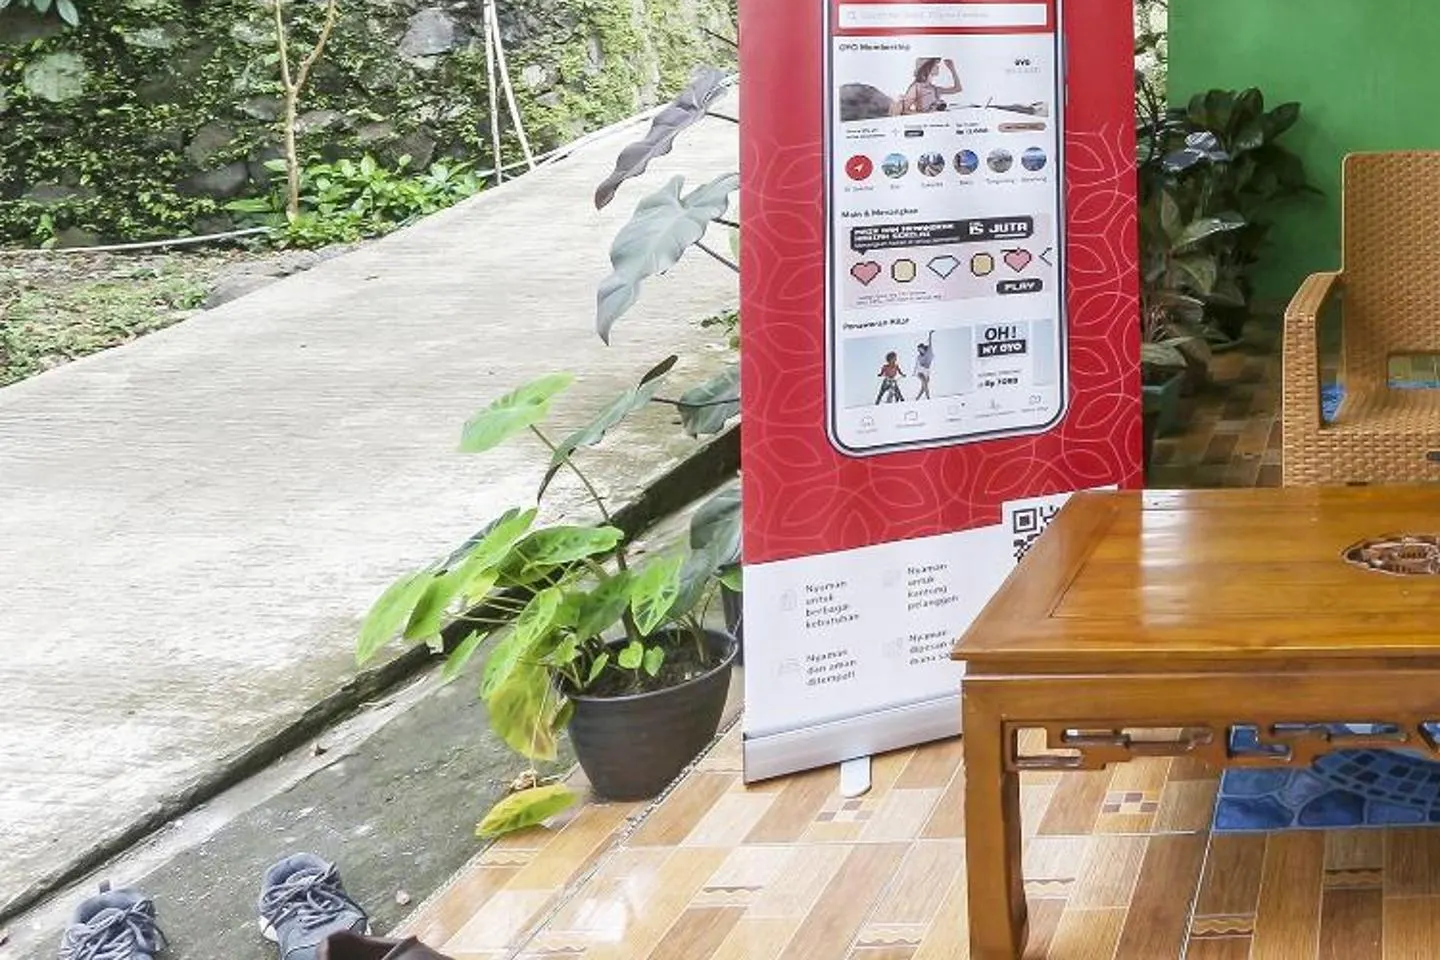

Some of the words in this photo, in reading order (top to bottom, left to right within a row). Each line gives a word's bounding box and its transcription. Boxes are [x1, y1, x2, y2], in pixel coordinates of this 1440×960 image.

[988, 222, 1028, 233] JUTA
[1003, 282, 1035, 291] PLAY
[1000, 343, 1022, 352] OYO
